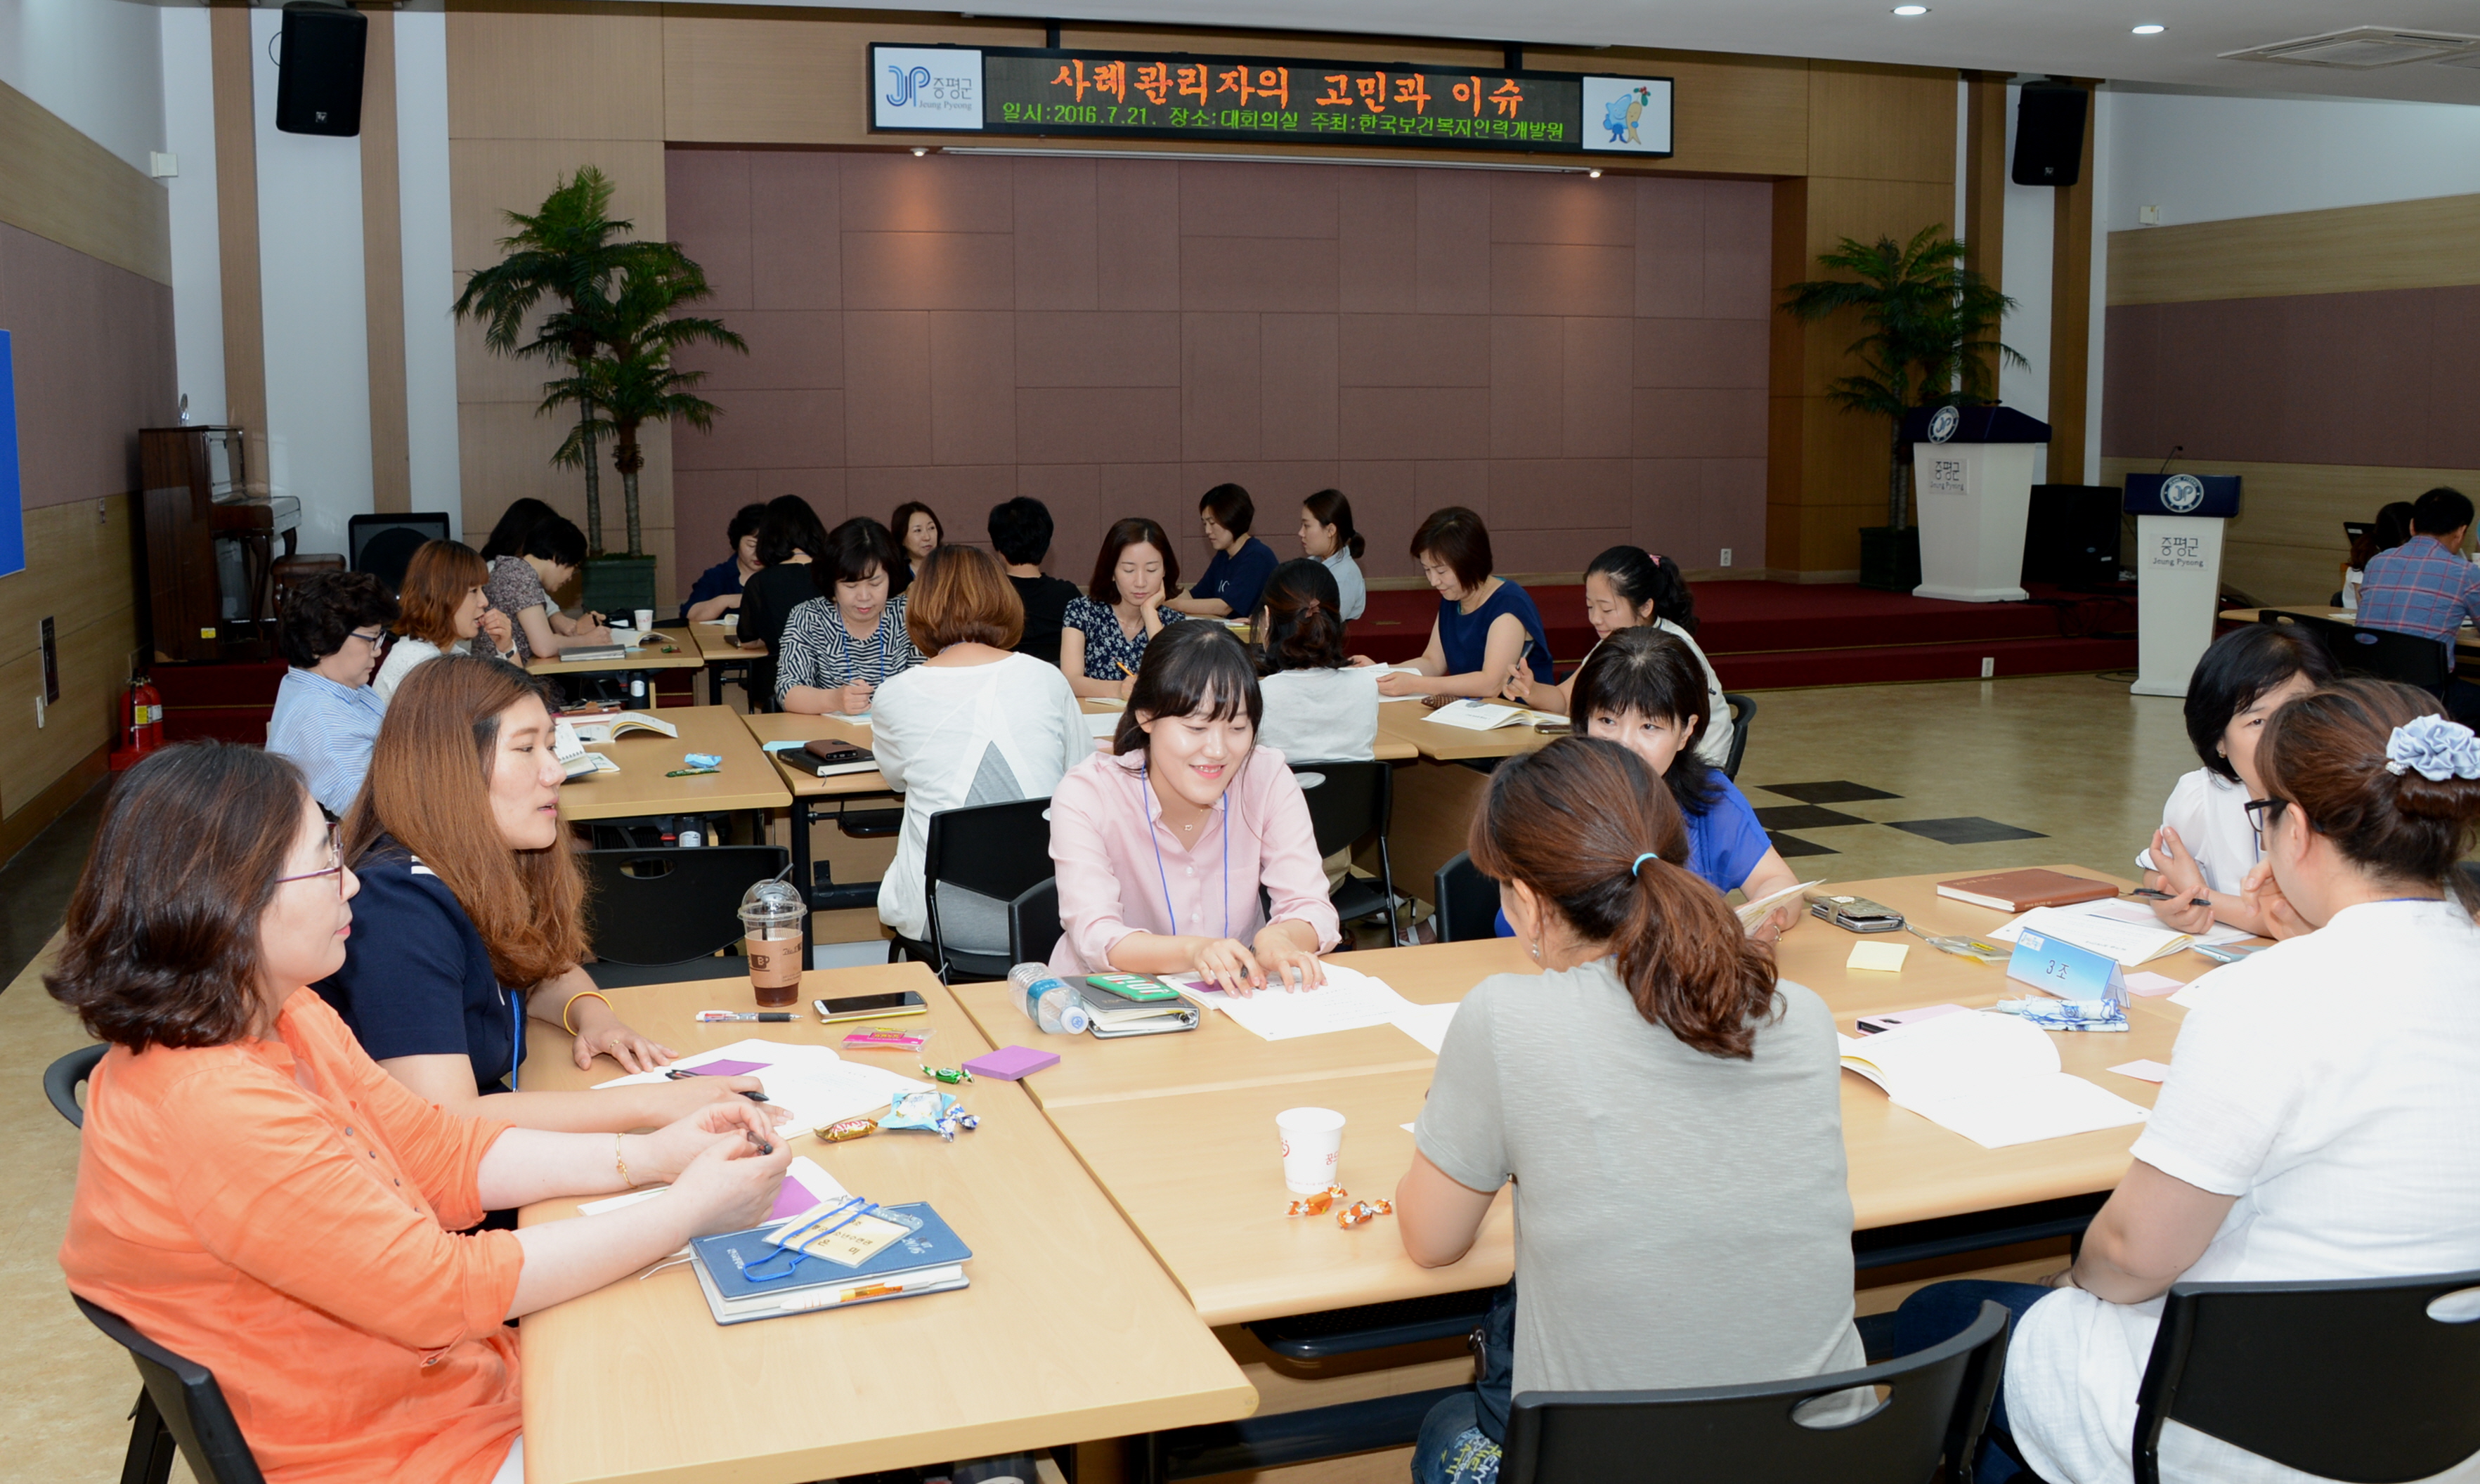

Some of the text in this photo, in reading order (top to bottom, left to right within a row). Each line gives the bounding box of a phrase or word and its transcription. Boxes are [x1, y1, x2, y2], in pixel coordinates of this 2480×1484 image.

[933, 77, 972, 99] 증평군
[1316, 71, 1431, 115] 고민과
[1453, 76, 1524, 119] 이슈
[919, 100, 972, 111] Jeung Pyeong
[1169, 108, 1299, 129] 장소:대회의실
[1311, 112, 1564, 141] 주최:한국보건복지인력개발원
[1935, 461, 1959, 481] 증평군
[2161, 537, 2198, 556] 증평군
[2153, 558, 2204, 568] Jeung Pyeong
